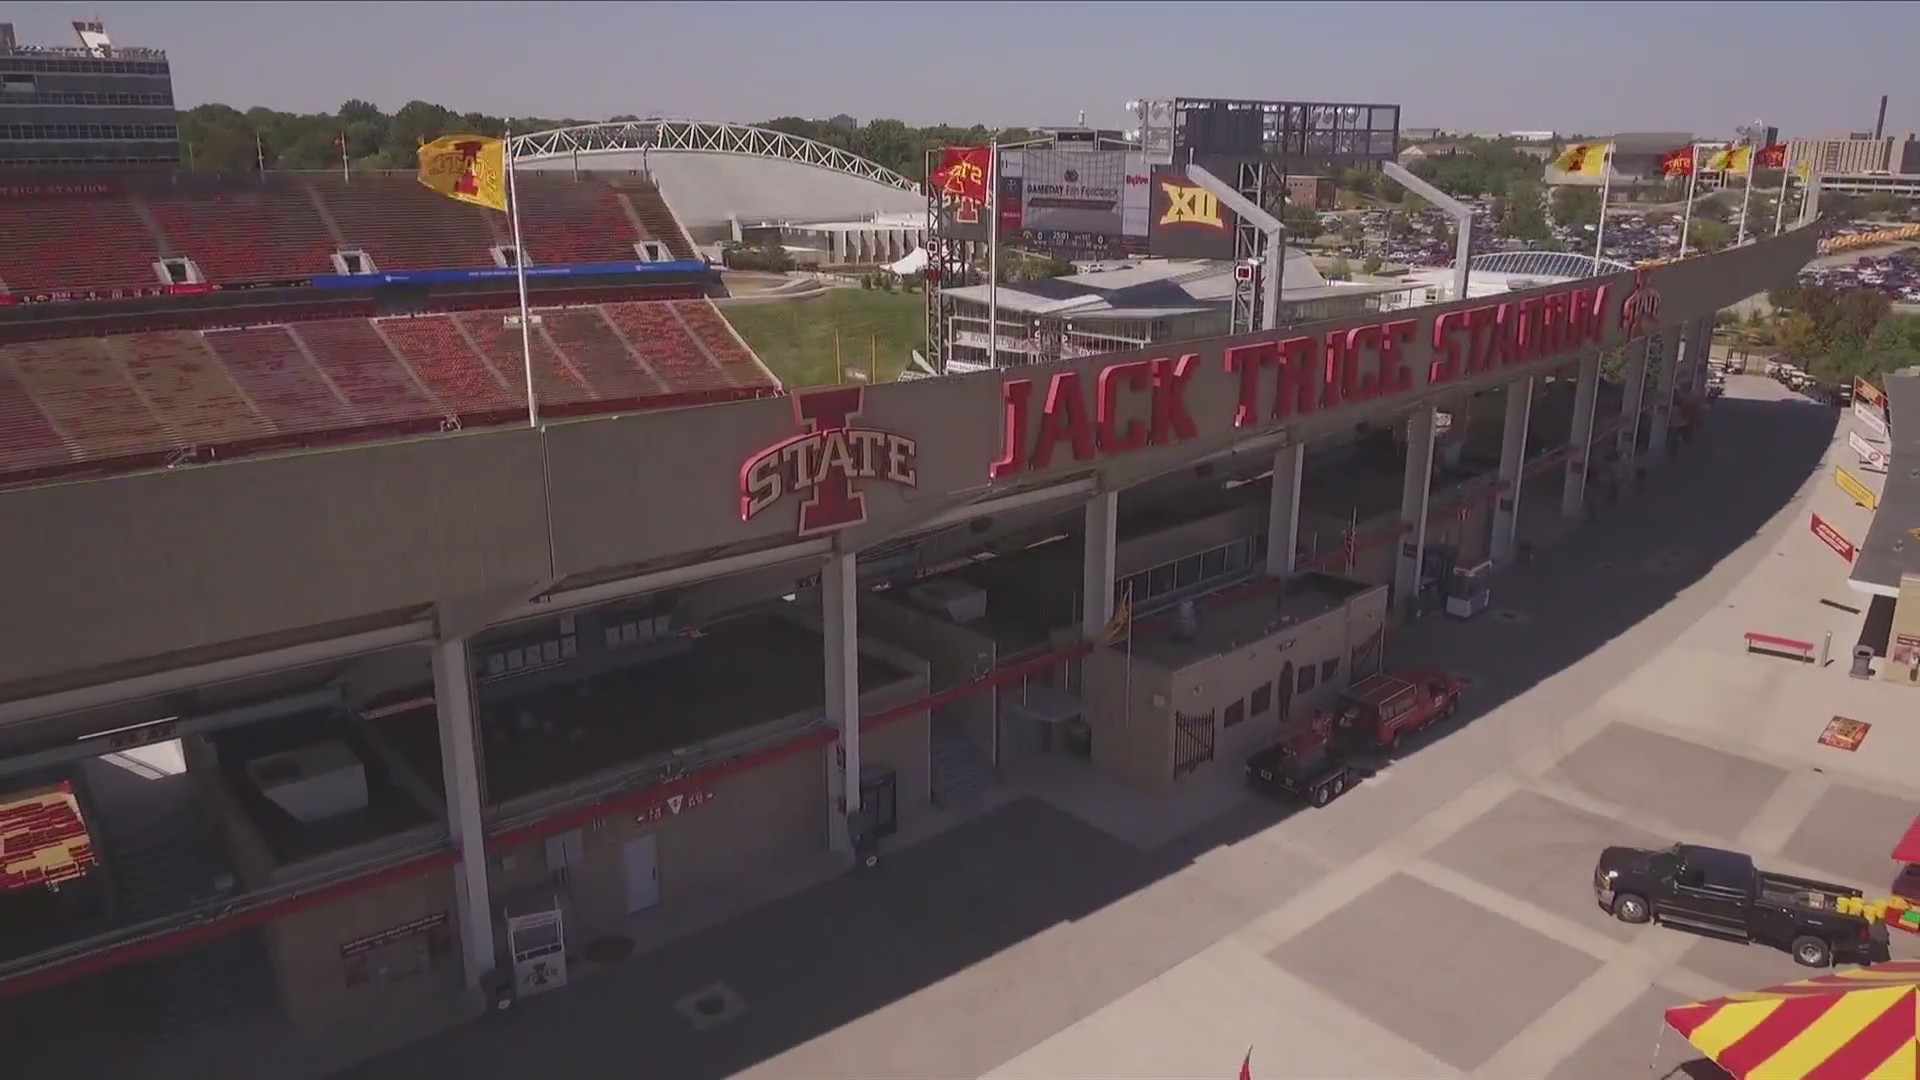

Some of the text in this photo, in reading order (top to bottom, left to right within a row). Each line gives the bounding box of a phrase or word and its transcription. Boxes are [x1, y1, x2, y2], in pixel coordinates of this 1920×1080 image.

[1160, 182, 1224, 228] XII
[988, 282, 1614, 478] JACK TRICE STADIUM
[741, 427, 918, 521] STATE
